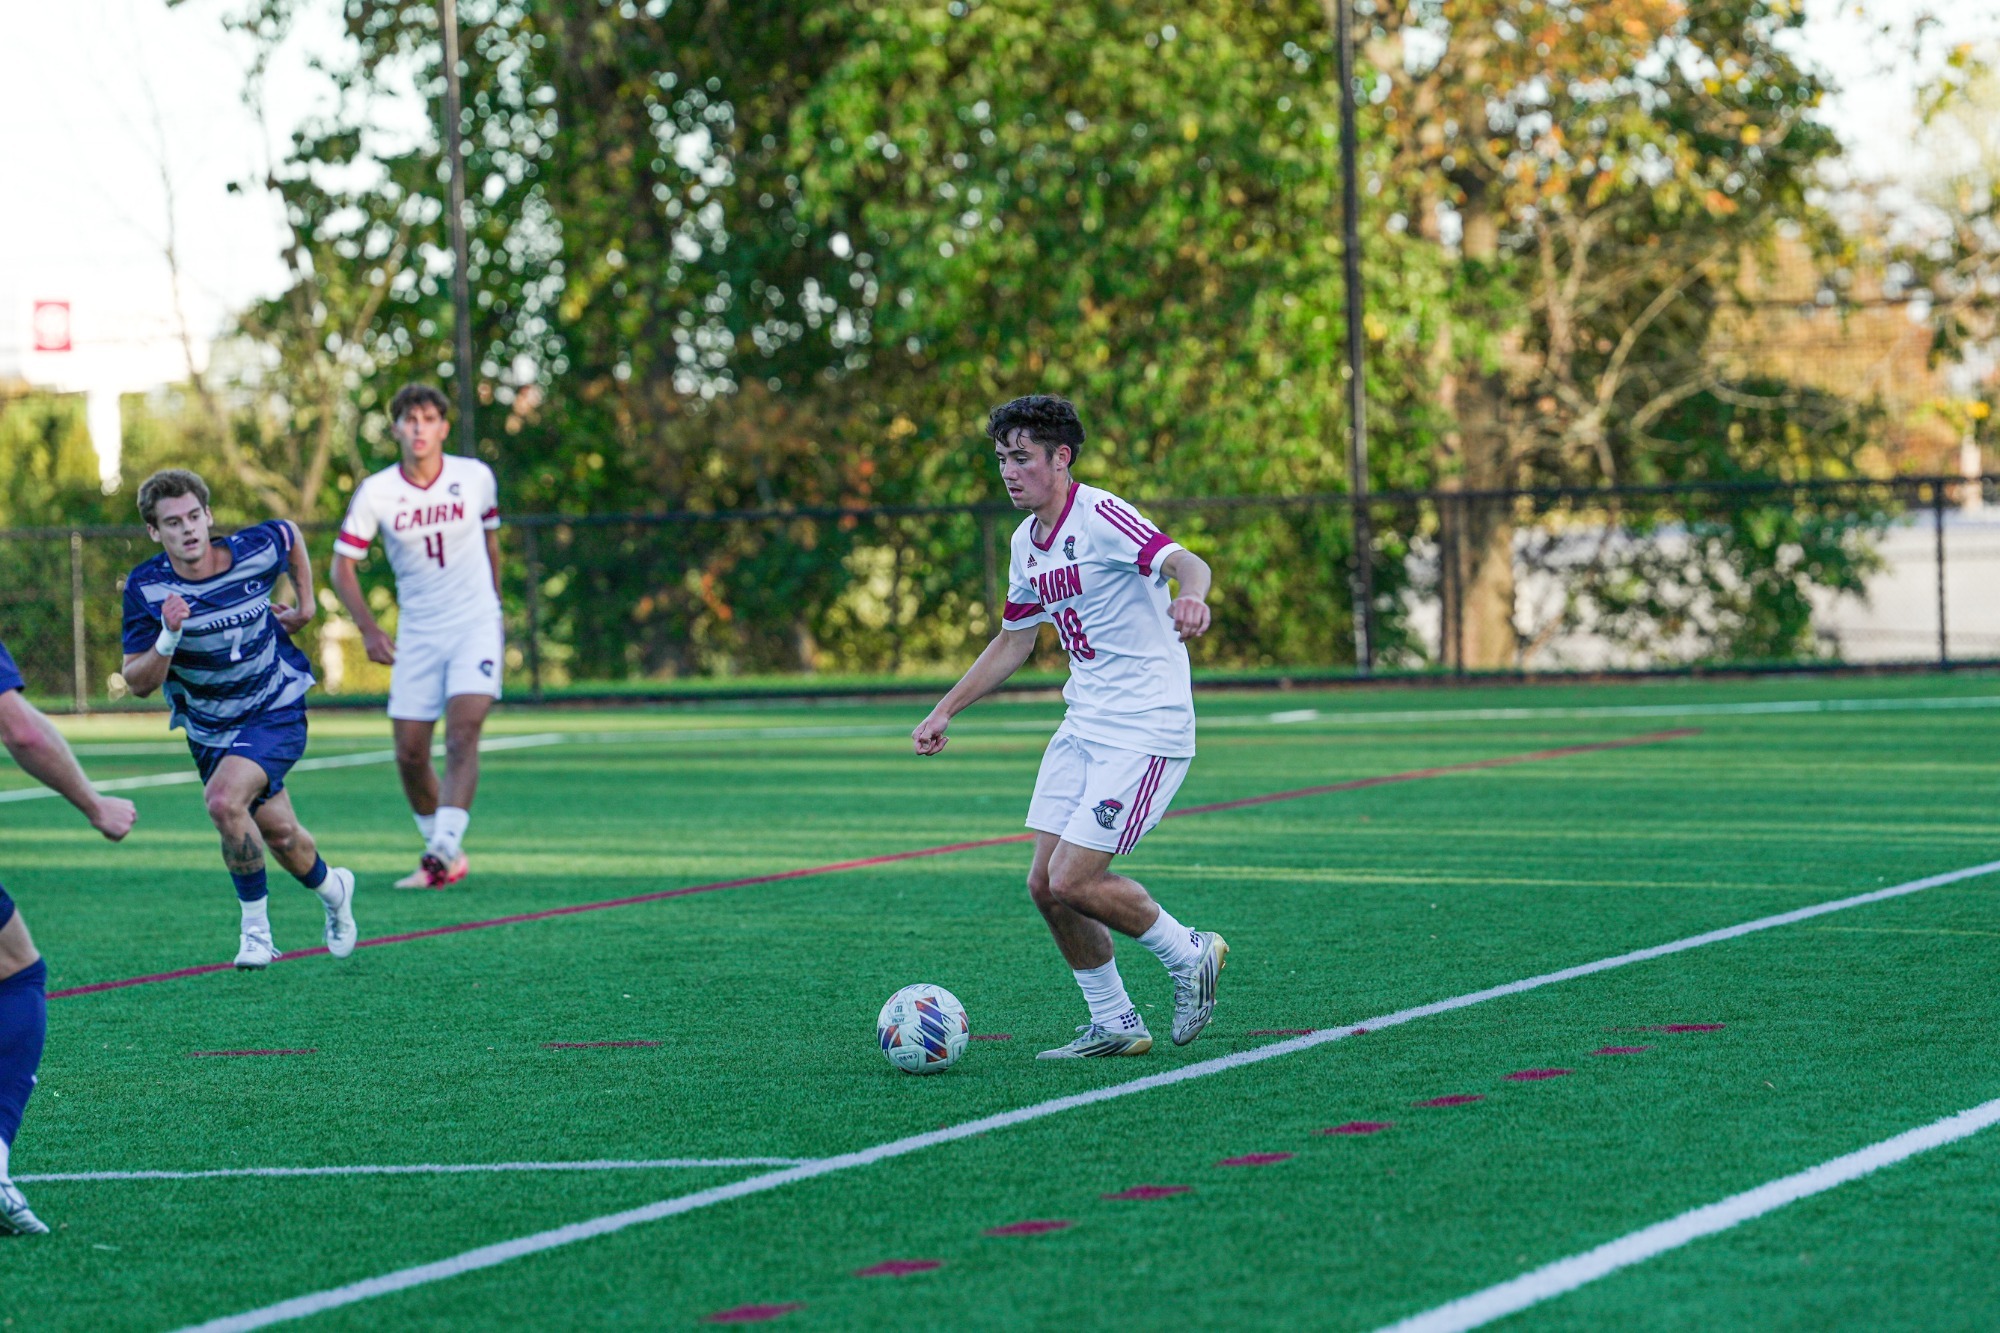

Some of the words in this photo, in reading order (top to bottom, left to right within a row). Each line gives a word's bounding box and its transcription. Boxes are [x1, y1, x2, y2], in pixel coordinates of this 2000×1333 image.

[394, 502, 464, 532] CAIRN
[424, 531, 445, 569] 4
[223, 627, 244, 662] 7
[1051, 606, 1095, 662] 18
